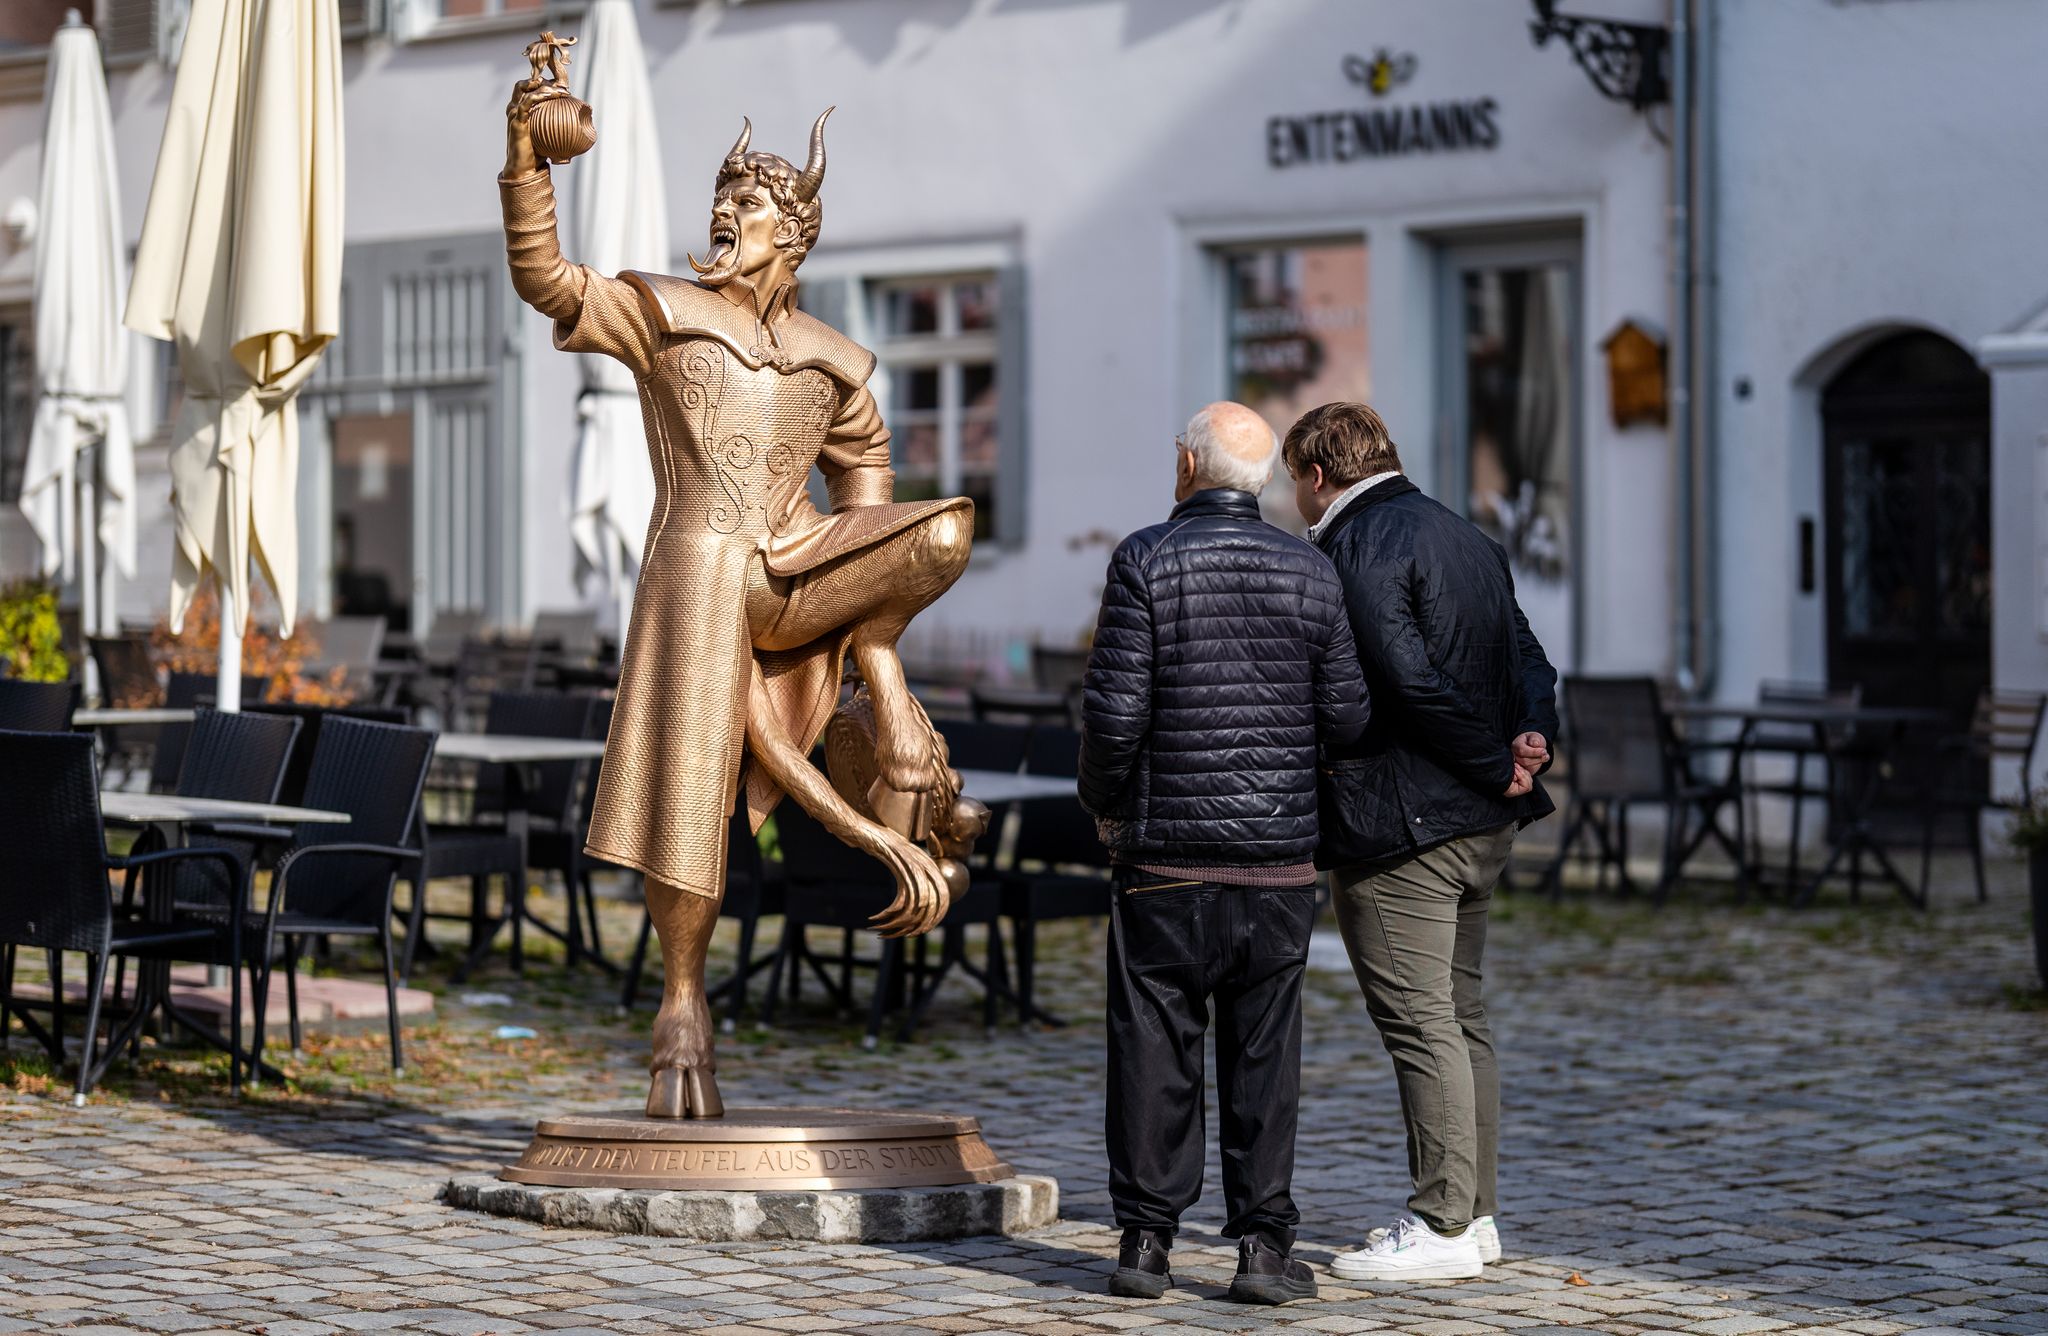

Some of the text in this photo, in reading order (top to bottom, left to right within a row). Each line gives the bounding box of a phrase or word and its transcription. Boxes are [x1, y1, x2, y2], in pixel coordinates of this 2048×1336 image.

[1267, 97, 1500, 168] ENTENMANNS
[549, 1145, 593, 1168] LIST
[592, 1147, 642, 1170] DEN
[650, 1149, 746, 1172] TEUFEL
[755, 1149, 812, 1172] AUS
[820, 1148, 875, 1171] DER
[879, 1145, 947, 1170] STADT
